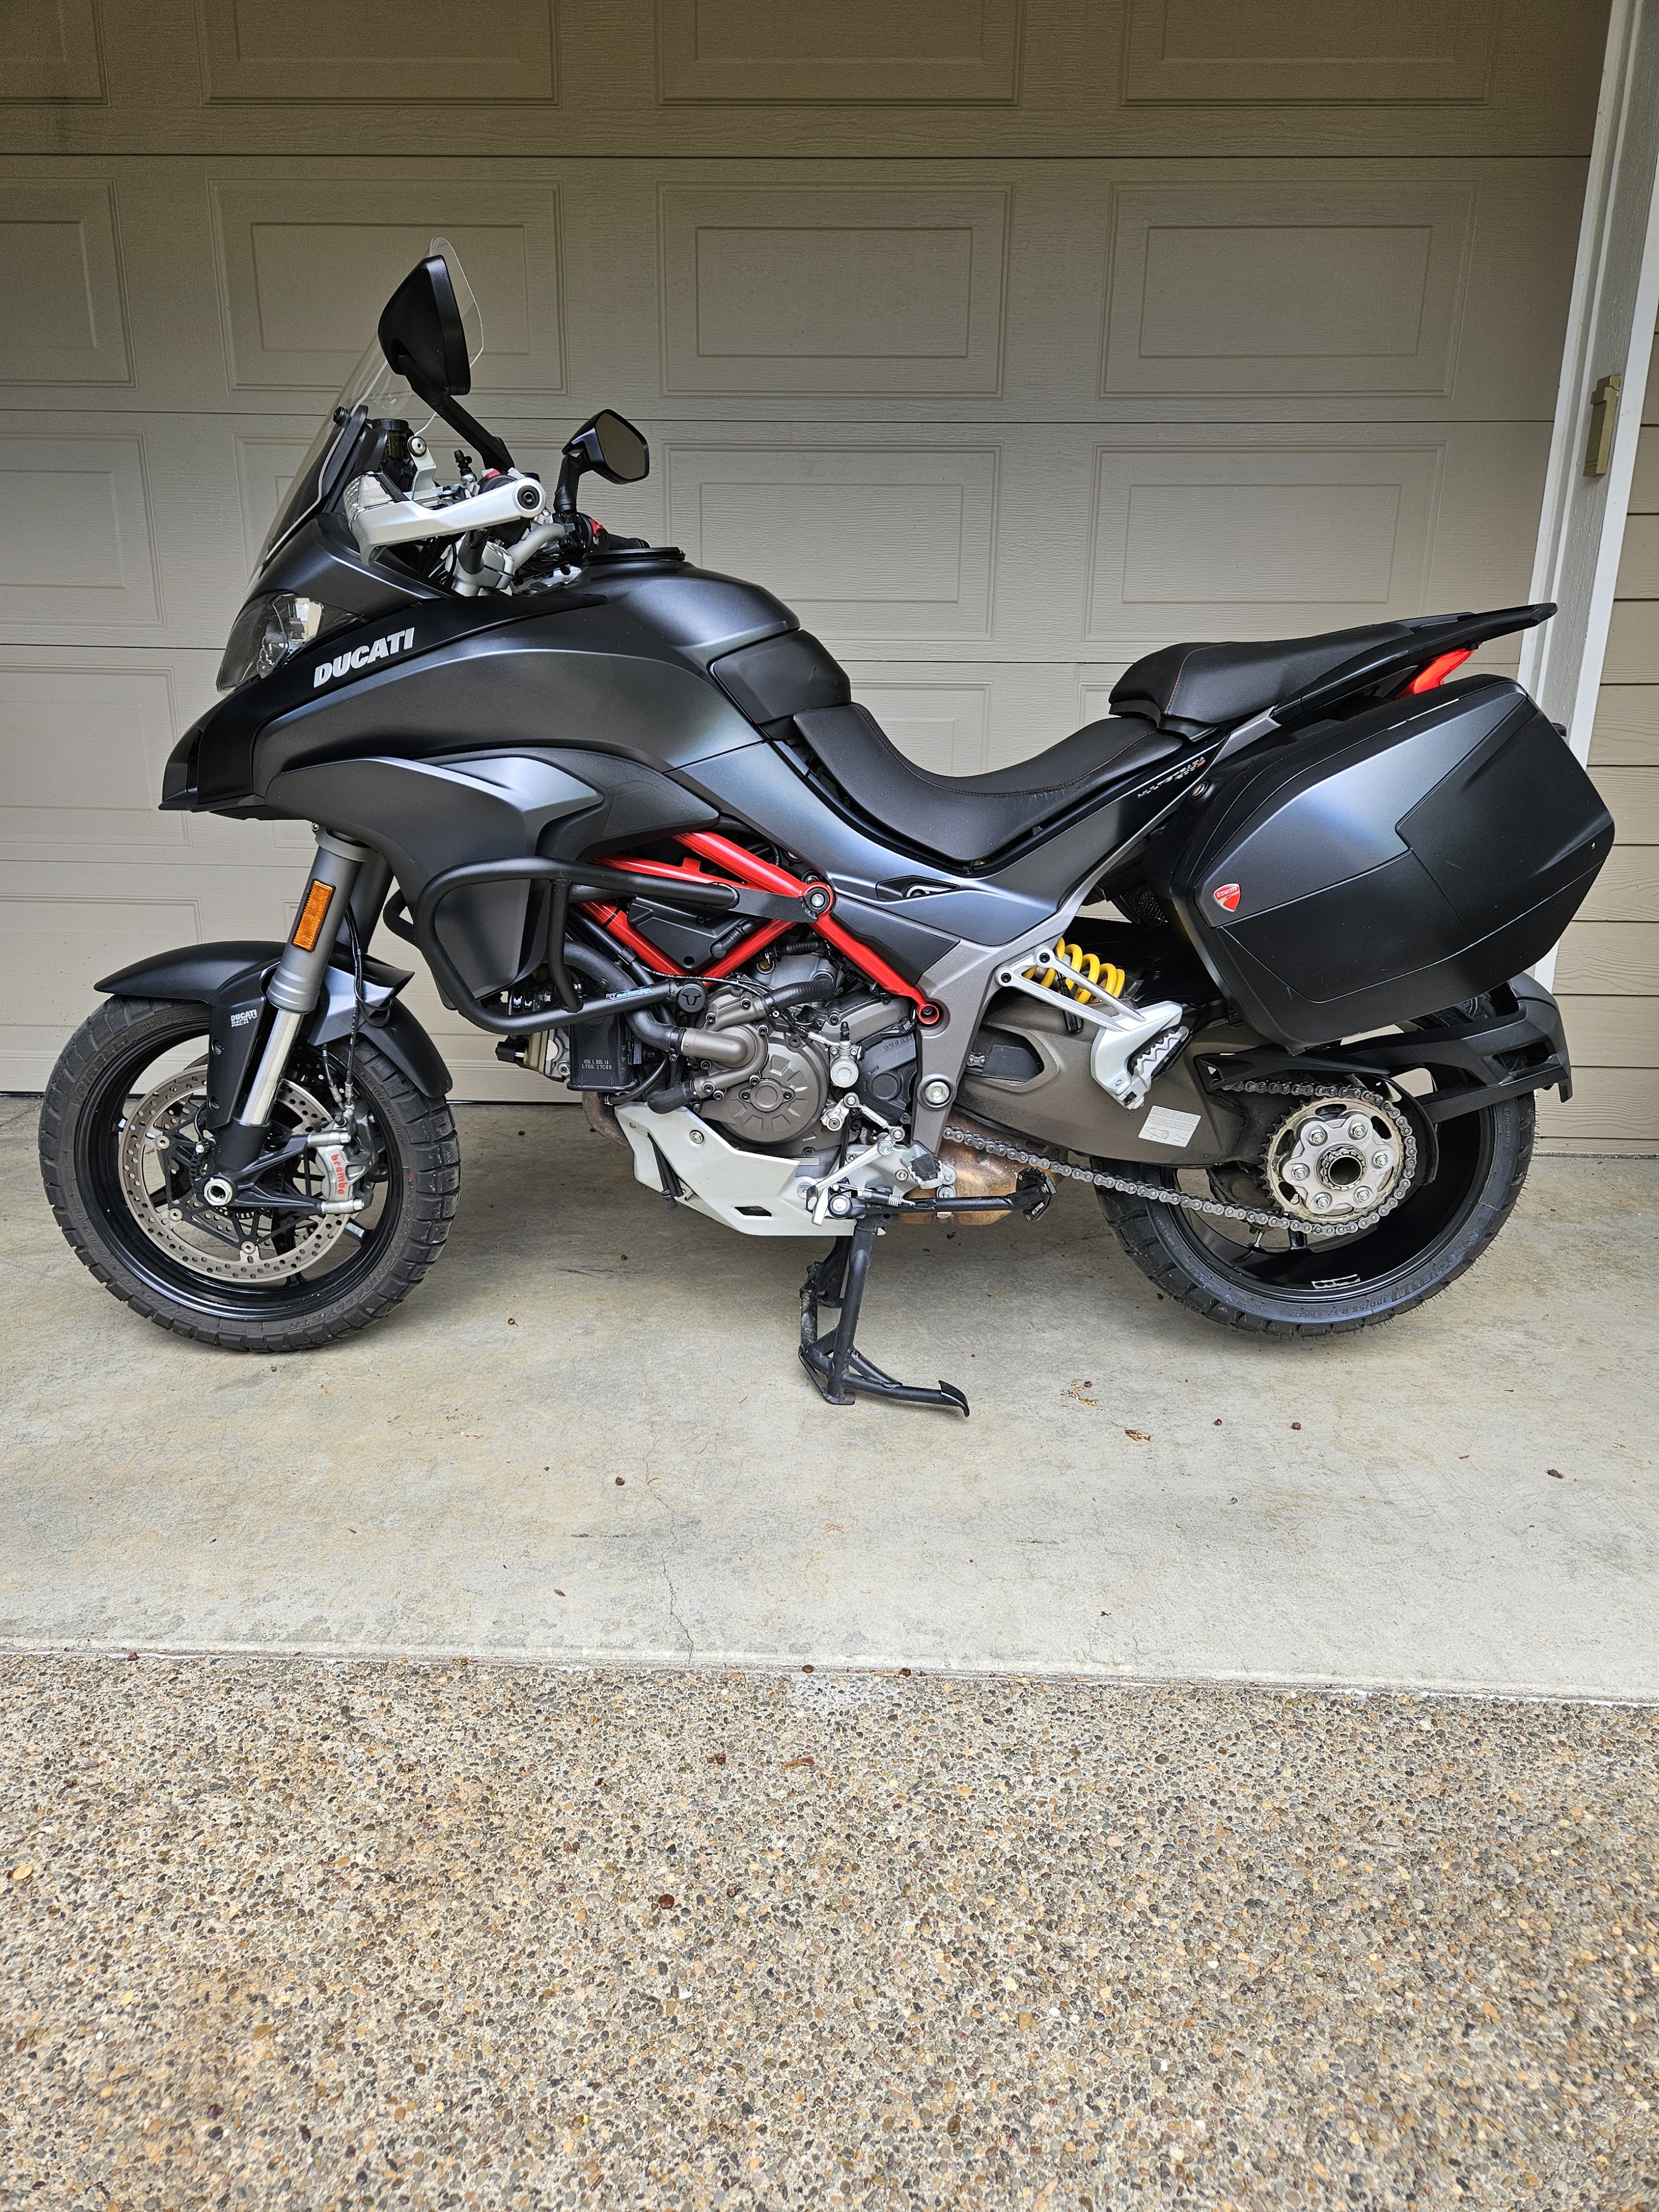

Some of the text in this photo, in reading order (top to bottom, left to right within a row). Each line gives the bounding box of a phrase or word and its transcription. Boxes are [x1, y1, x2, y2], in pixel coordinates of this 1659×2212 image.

[314, 627, 415, 688] DUCATI
[1217, 886, 1237, 898] DUCATI
[231, 1009, 257, 1022] DUCATI
[231, 1015, 258, 1025] SAFETY
[75, 1032, 134, 1101] PIRELLI
[331, 1154, 348, 1195] brembo
